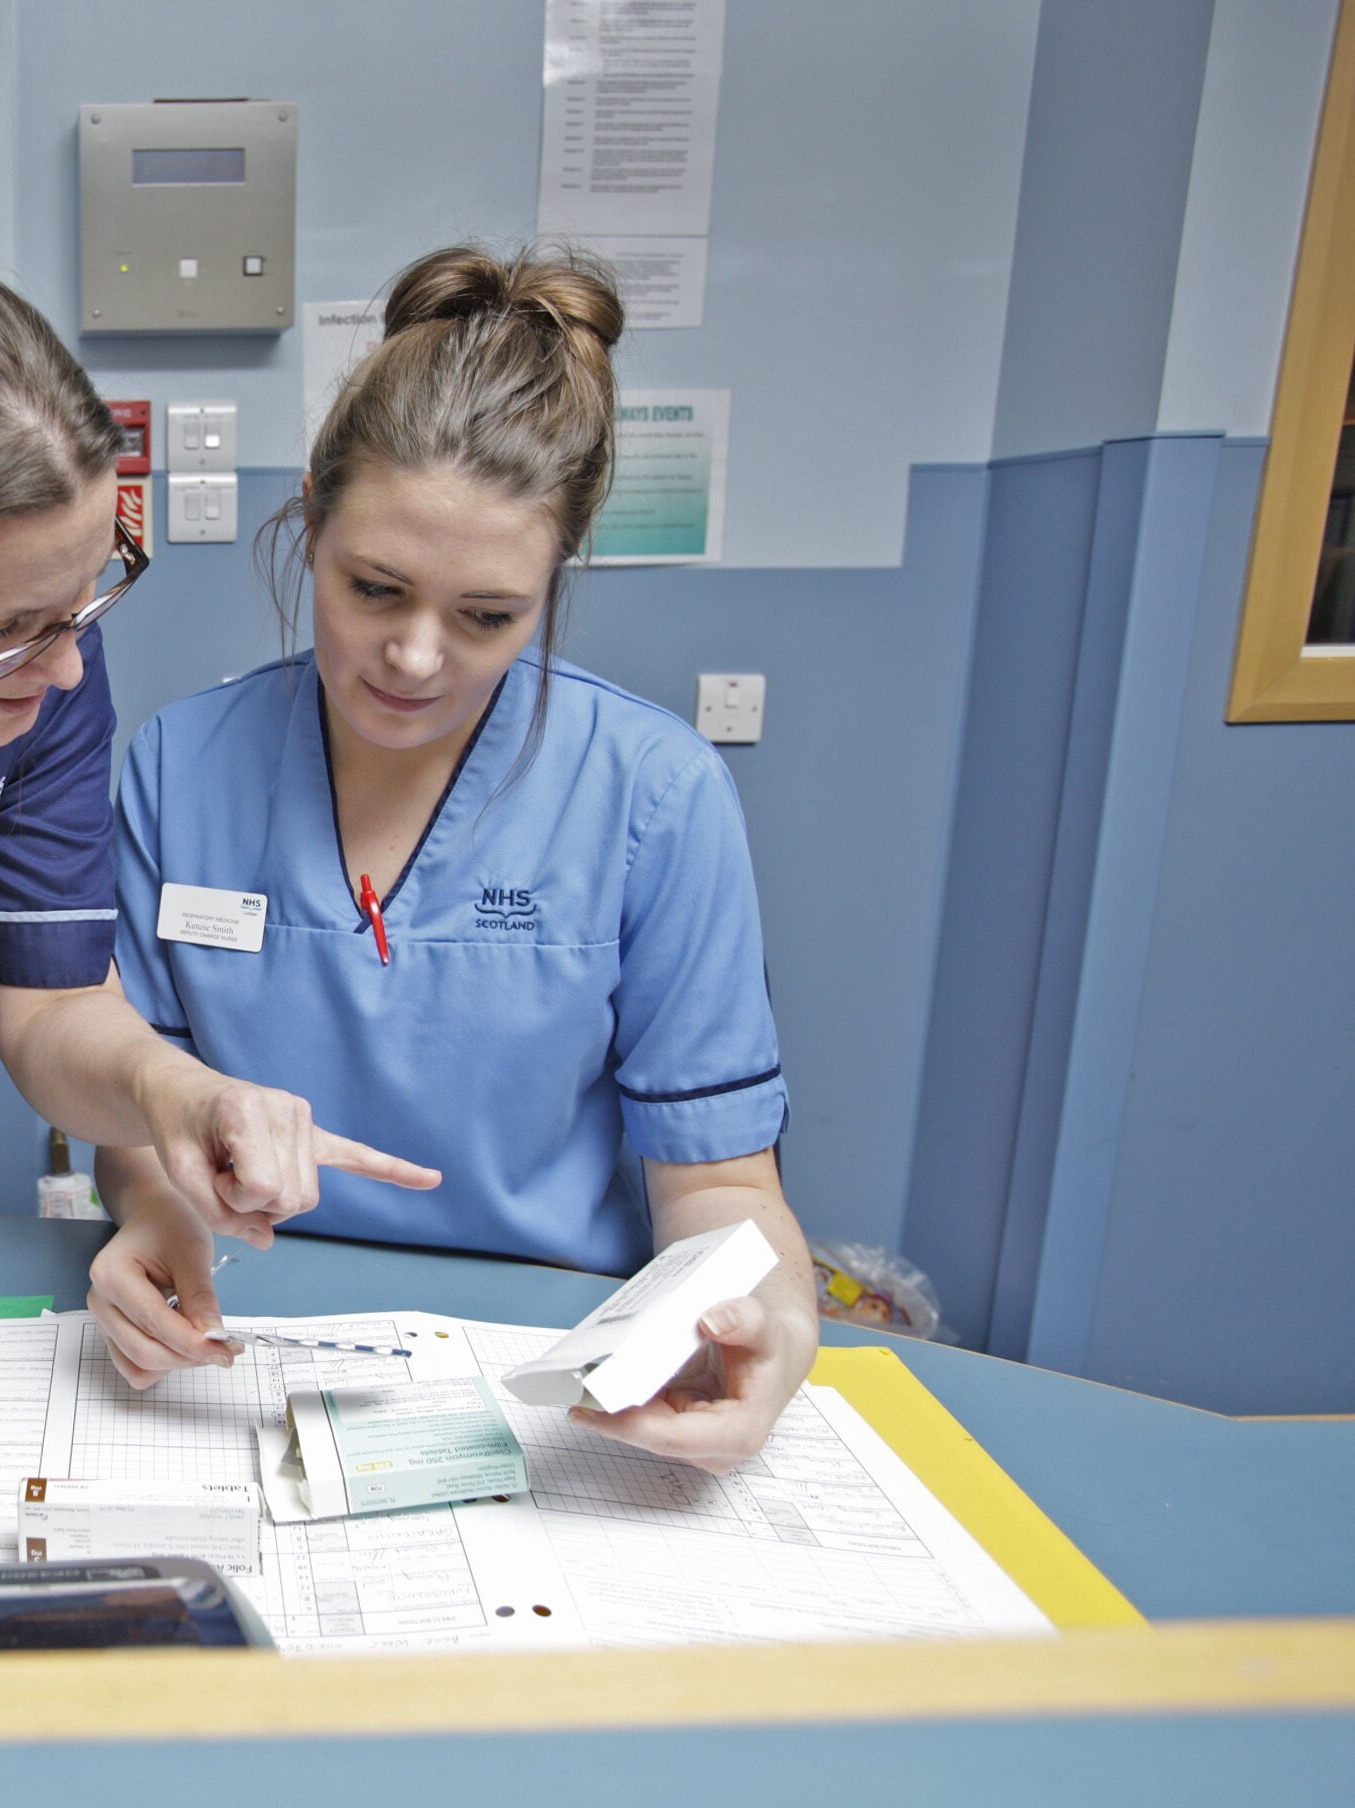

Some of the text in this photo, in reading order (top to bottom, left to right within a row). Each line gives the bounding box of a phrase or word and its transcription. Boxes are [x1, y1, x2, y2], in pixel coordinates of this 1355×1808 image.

[318, 313, 377, 326] Infection
[652, 405, 694, 421] EVENTS
[242, 898, 262, 908] NHS
[482, 888, 531, 907] NHS
[182, 912, 240, 925] RESPIRATORY MEDICINE
[475, 918, 535, 931] SCOTLAND
[185, 920, 234, 935] Kenzie Smith
[180, 929, 239, 943] DEPUTY CHARGE NURSE
[420, 1441, 508, 1456] Film-coated Tablets
[408, 1448, 511, 1466] Clarithromycin 250 mg
[202, 1484, 249, 1492] Tablets
[30, 1549, 42, 1557] mg
[227, 1564, 252, 1573] Folic
[397, 1615, 456, 1626] PRESCRIPTION
